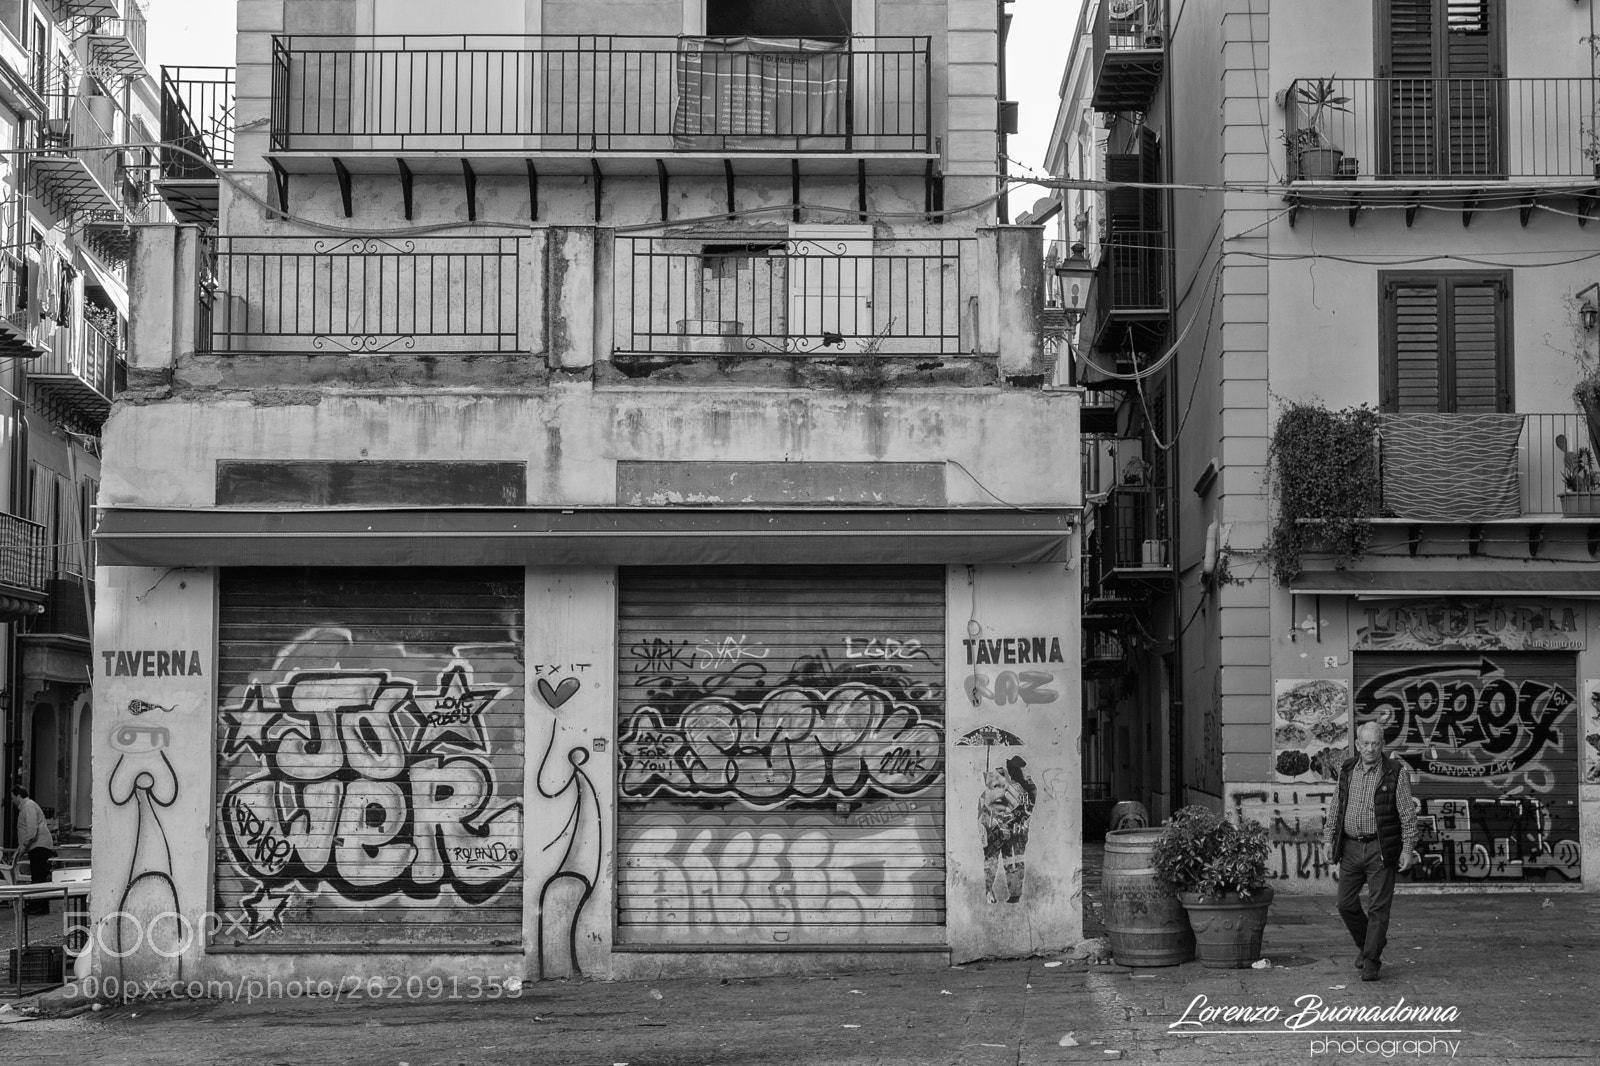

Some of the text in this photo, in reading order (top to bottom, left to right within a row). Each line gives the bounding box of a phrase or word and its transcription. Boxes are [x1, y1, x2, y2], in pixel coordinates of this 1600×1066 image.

[1362, 606, 1578, 633] TRATTORIA
[102, 650, 203, 678] TAVERNA
[962, 637, 1064, 665] TAVERNA
[534, 663, 592, 675] EXIT
